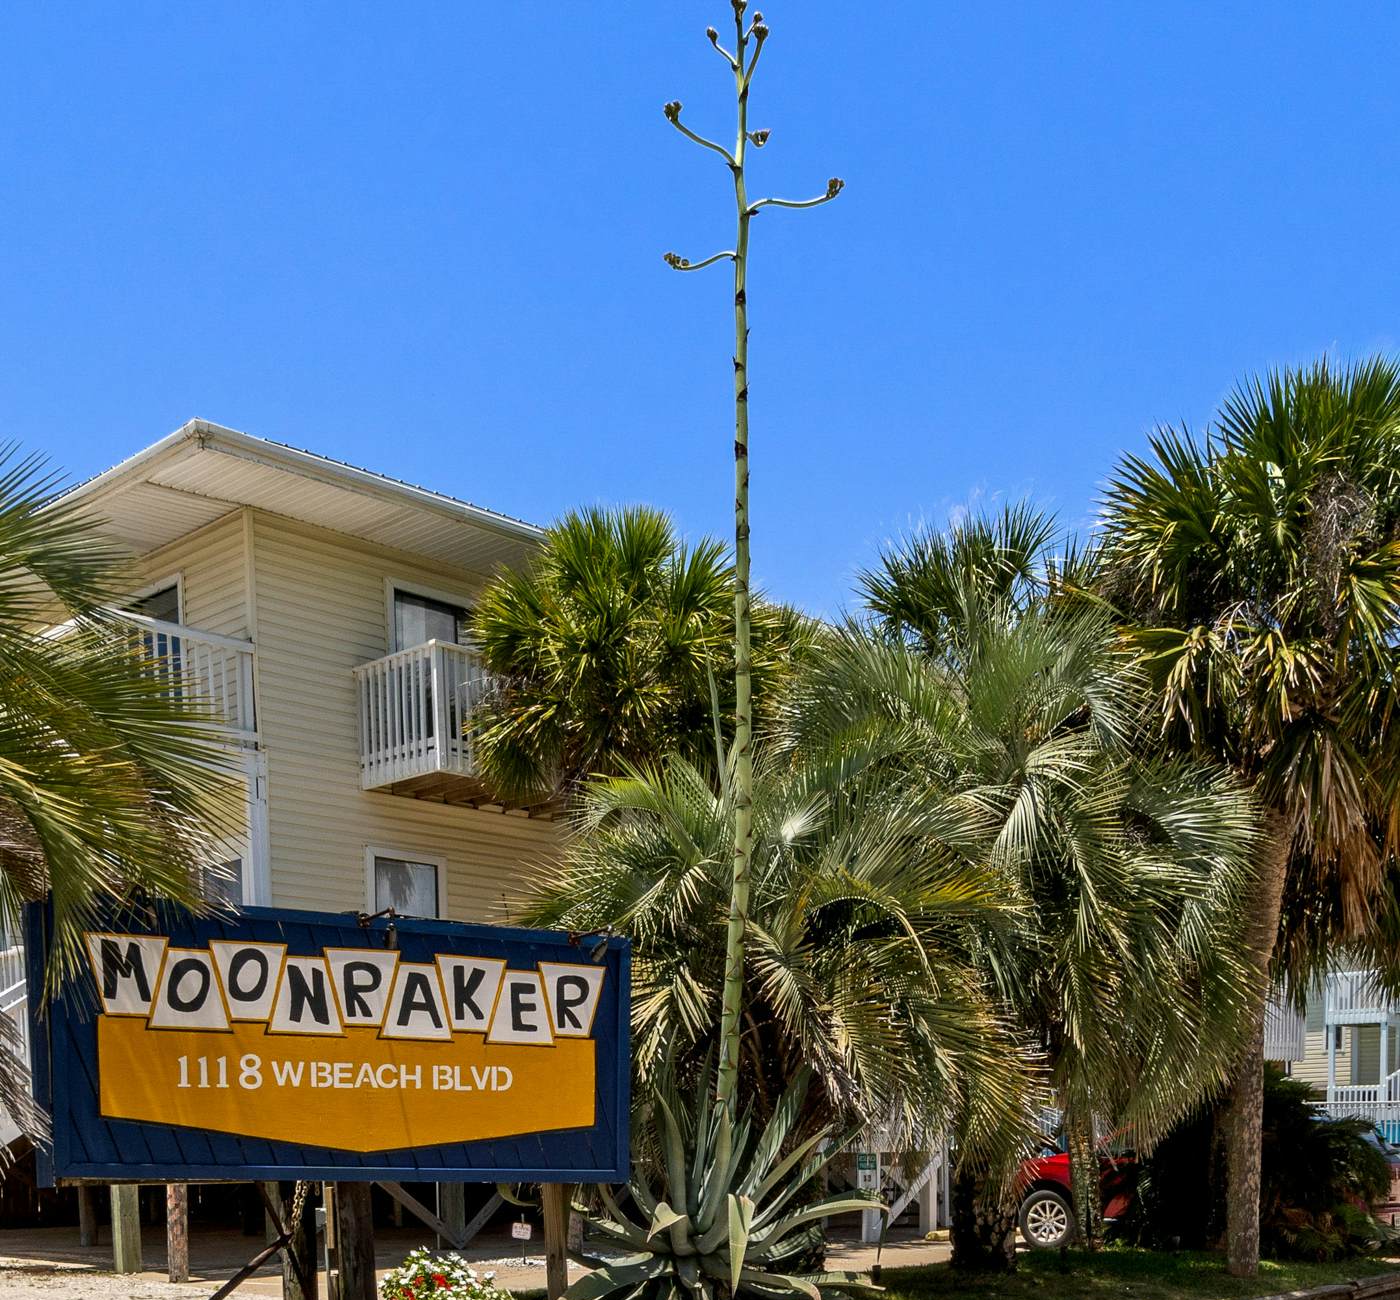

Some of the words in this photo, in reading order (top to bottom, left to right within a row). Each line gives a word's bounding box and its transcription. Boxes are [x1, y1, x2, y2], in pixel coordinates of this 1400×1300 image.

[101, 938, 590, 1032] MOONRAKER
[177, 1053, 263, 1089] 1118
[271, 1060, 305, 1087] W
[310, 1061, 422, 1089] BEACH
[432, 1065, 513, 1092] BLVD
